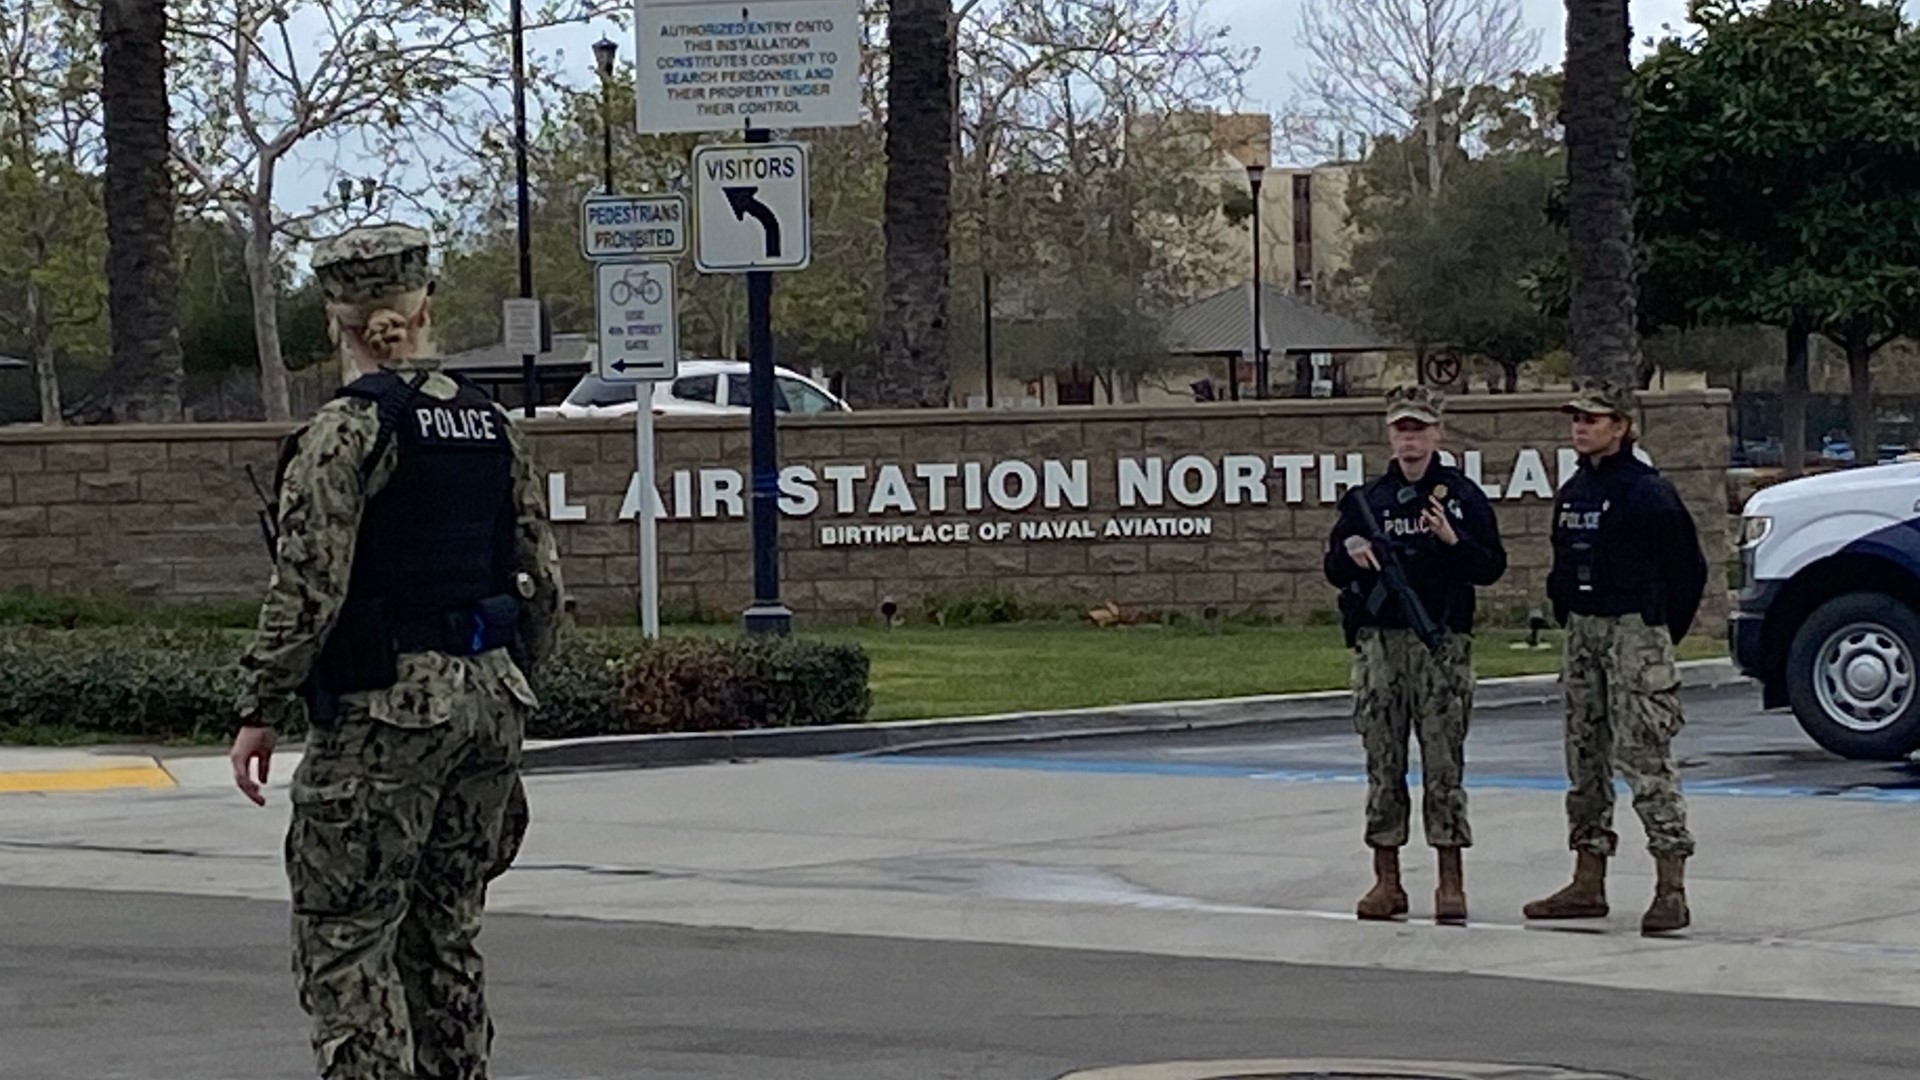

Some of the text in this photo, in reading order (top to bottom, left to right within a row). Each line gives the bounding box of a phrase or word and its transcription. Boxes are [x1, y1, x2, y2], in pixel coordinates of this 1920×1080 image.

[660, 19, 834, 37] AUTHORIZED ENTRY ONTO
[684, 37, 811, 52] THIS INSTALLATION
[656, 52, 838, 69] CONSTITUTES CONSENT TO
[664, 68, 834, 85] SEARCH PERSONNEL AND
[667, 84, 830, 100] THEIR PROPERTY UNDER
[696, 100, 802, 116] THEIR CONTROL
[705, 157, 795, 181] VISITORS
[588, 204, 680, 225] PEDESTRIANS
[594, 228, 675, 249] PROHIBITED
[416, 408, 497, 440] POLICE
[618, 468, 744, 520] AIR
[777, 459, 1088, 516] STATION
[1117, 453, 1364, 507] NORTH
[821, 517, 1212, 545] BIRTHPLACE OF NAVAL AVIATION
[1384, 518, 1431, 536] POLIC
